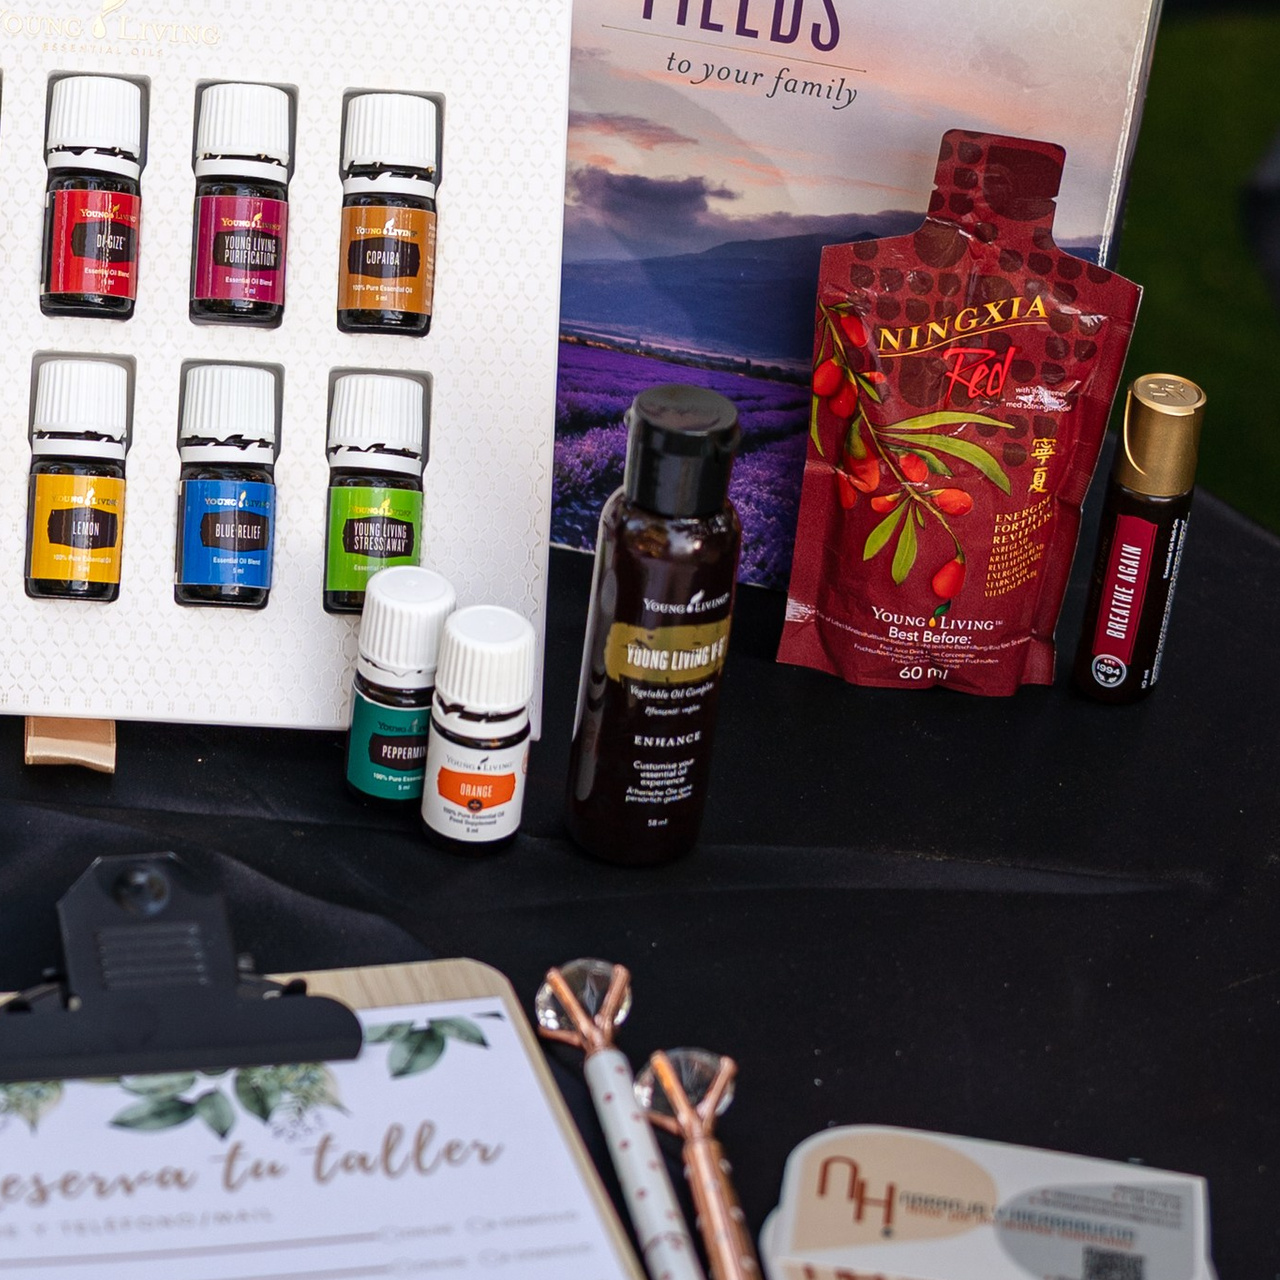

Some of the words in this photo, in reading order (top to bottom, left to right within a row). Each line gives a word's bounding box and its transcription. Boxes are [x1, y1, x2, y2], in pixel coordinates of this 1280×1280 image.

[119, 15, 220, 45] LIVING
[42, 42, 122, 55] ESSENTIAL
[131, 47, 164, 57] OILS
[667, 51, 691, 74] to
[691, 62, 763, 86] your
[766, 68, 858, 110] family
[225, 236, 251, 250] YOUNG
[254, 237, 276, 253] LIVING
[224, 250, 275, 266] PURIFICATION
[367, 250, 399, 265] COPAIBA
[879, 294, 1049, 352] NINGXIA
[943, 346, 1016, 410] Red
[996, 494, 1052, 523] ENERGISE
[73, 521, 99, 536] LEMON
[215, 524, 235, 538] BLUE
[238, 525, 261, 539] RELIEF
[354, 522, 380, 536] YOUNG
[383, 523, 407, 538] LIVING
[354, 536, 383, 551] STRESS
[386, 538, 406, 552] AWAY
[1117, 544, 1142, 584] AGAIN
[644, 598, 686, 614] YOUNG
[1106, 584, 1135, 640] BREATHE
[872, 606, 925, 627] YOUNG
[940, 616, 994, 630] LIVING
[889, 626, 919, 641] Best
[923, 630, 972, 644] Before:
[627, 643, 669, 670] YOUNG
[671, 645, 710, 671] LIVING
[900, 666, 922, 680] 60
[927, 667, 948, 679] ml
[1096, 663, 1120, 676] 1994
[630, 684, 669, 699] Vegetable
[671, 689, 684, 699] Oil
[634, 730, 701, 747] ENHANCE
[382, 745, 426, 759] PEPPERMIN
[446, 755, 475, 770] YOUNG
[483, 762, 513, 771] LIVING
[633, 760, 677, 770] Customise
[460, 783, 493, 798] ORANGE
[211, 1140, 286, 1195] tu
[302, 1119, 504, 1187] taller
